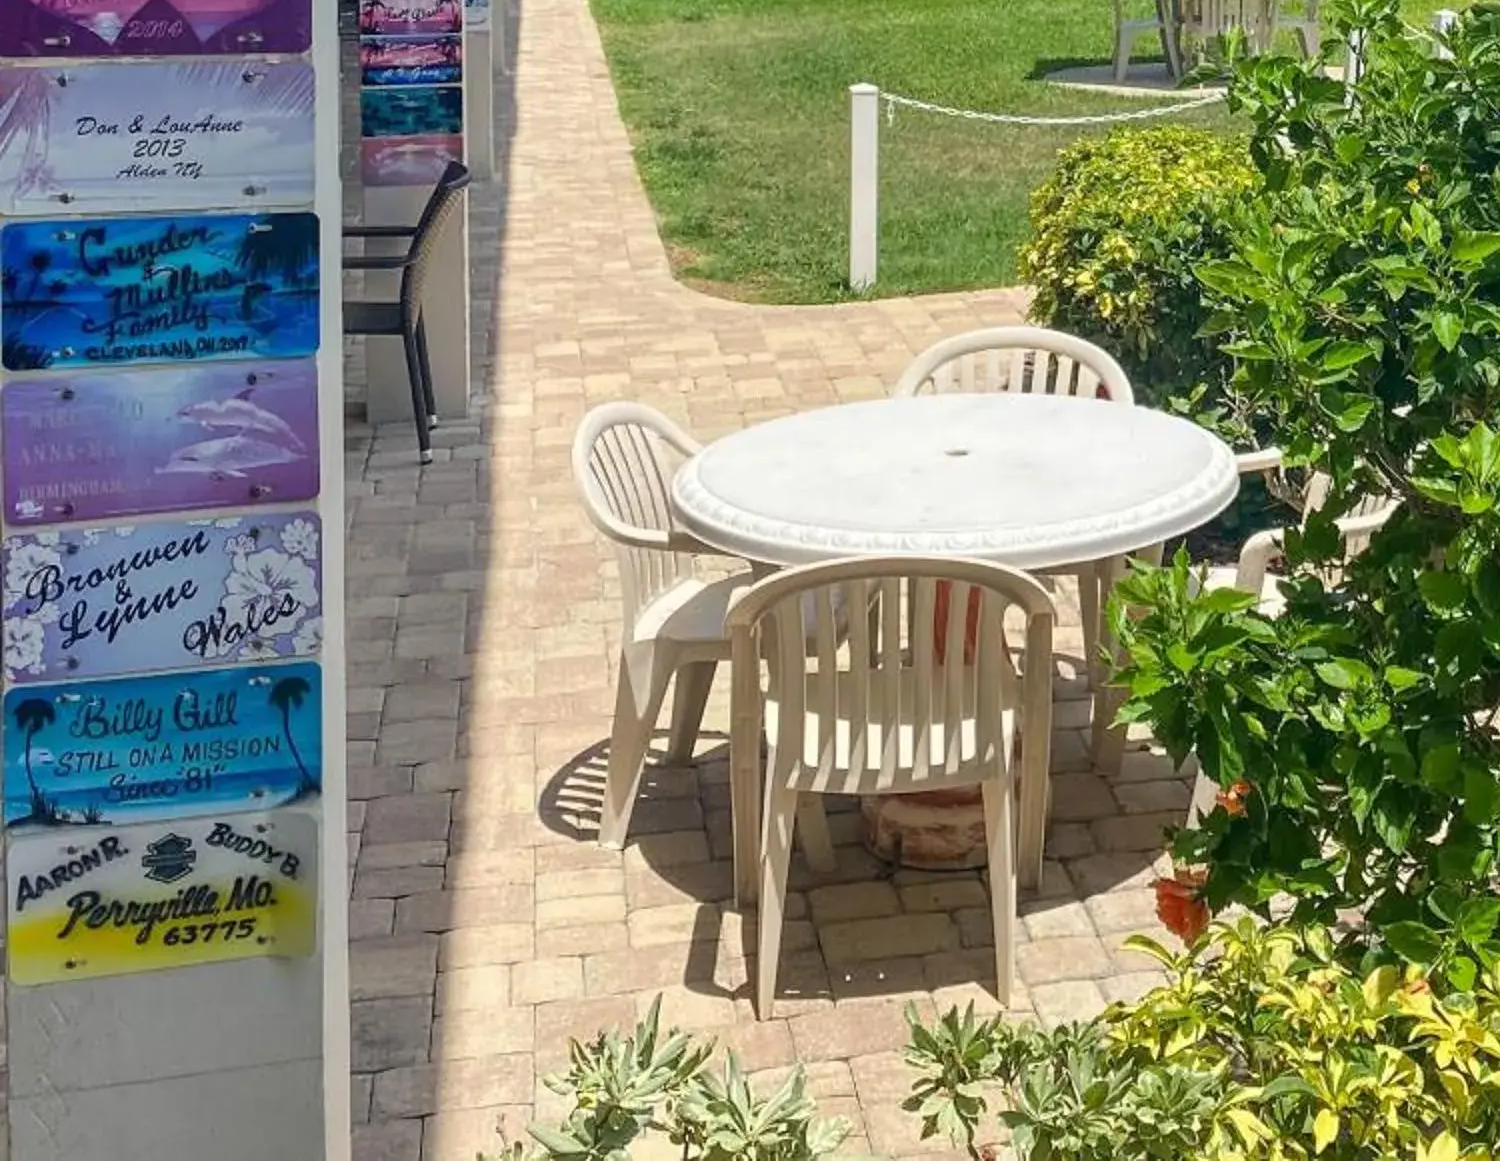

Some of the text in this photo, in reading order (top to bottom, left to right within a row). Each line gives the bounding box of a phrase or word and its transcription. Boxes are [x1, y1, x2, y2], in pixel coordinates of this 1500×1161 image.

[75, 116, 118, 137] Don
[127, 115, 144, 134] &
[133, 138, 187, 158] 2013
[25, 530, 212, 614] Bronwen
[115, 578, 133, 604] &
[59, 578, 200, 650] Lynne
[183, 592, 302, 657] Wales
[69, 688, 239, 742] Billy Gill
[53, 749, 119, 777] STILL
[182, 737, 281, 763] MISSION
[205, 822, 284, 864] BUDDY
[16, 846, 101, 912] AARON
[163, 917, 257, 946] 63775
